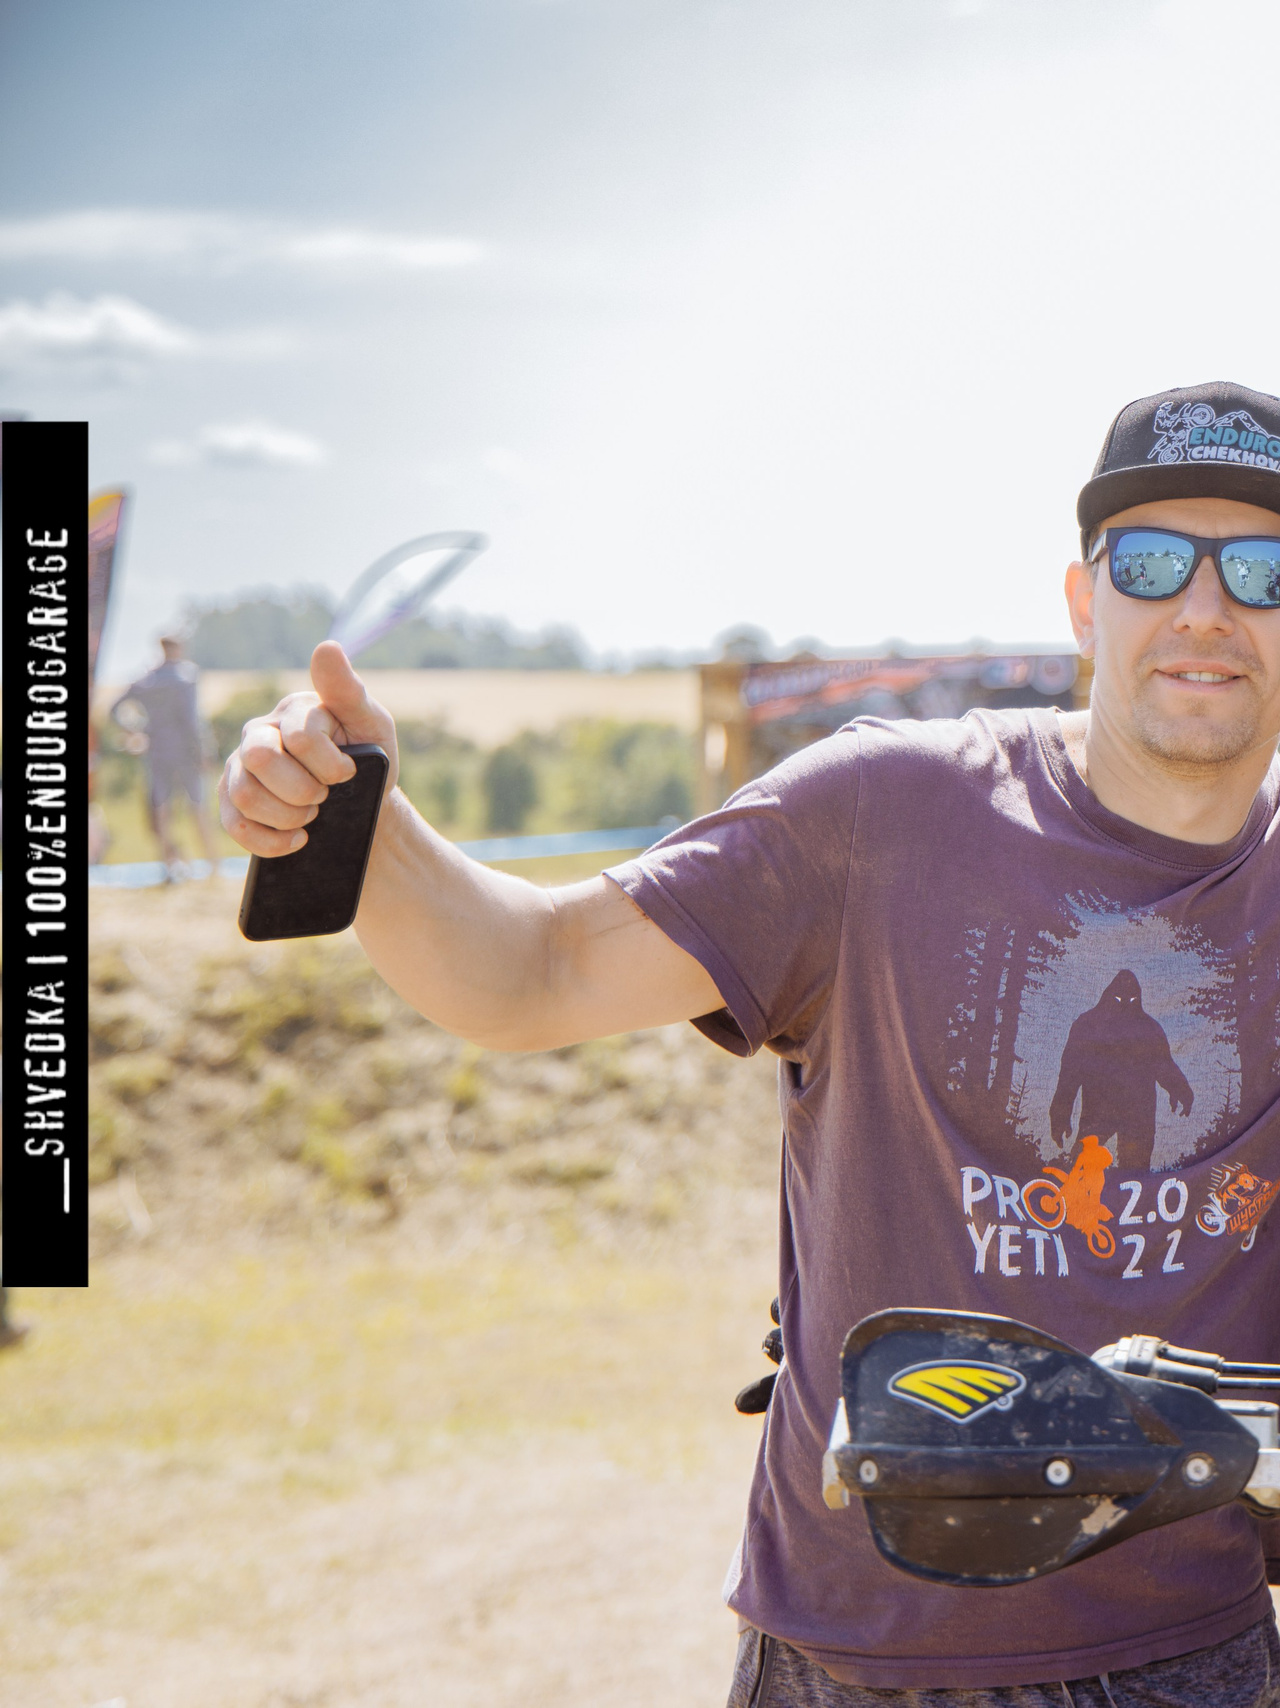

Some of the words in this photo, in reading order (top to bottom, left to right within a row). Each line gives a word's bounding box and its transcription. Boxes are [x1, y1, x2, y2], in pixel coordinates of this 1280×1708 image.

[1190, 445, 1280, 470] CHEKHOV
[1118, 1177, 1189, 1225] 2.0
[966, 1222, 1069, 1277] YETI
